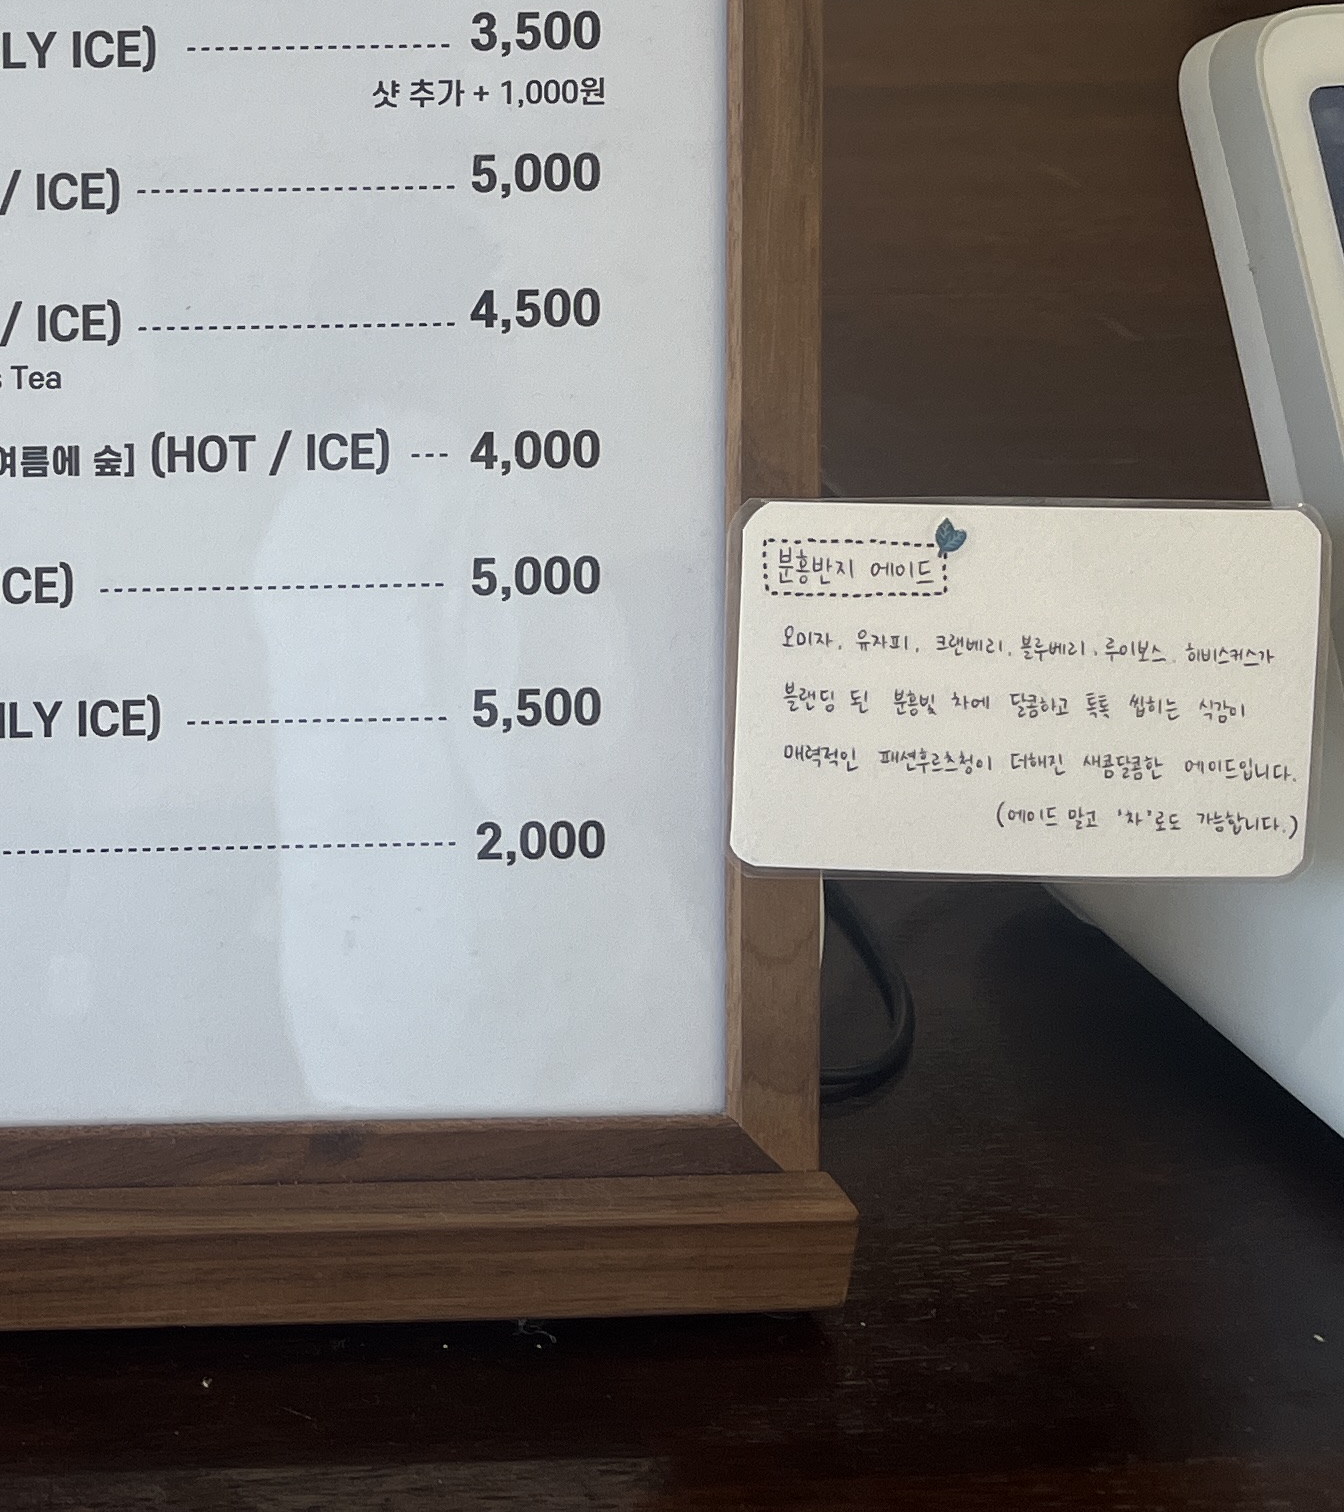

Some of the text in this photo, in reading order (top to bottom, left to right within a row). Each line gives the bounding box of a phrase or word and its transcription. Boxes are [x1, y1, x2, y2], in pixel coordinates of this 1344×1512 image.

[73, 25, 155, 72] ICE)
[471, 11, 600, 57] 3,500
[373, 80, 400, 108] 샷
[410, 79, 465, 107] 추가
[474, 86, 489, 101] +
[502, 78, 604, 108] 1,000원
[0, 301, 22, 347] /
[38, 299, 120, 346] ICE)
[470, 288, 600, 334] 4,500
[11, 366, 61, 389] Tea
[94, 444, 134, 477] 숲]
[152, 432, 256, 478] (HOT
[269, 430, 292, 476] /
[307, 428, 389, 475] ICE)
[470, 430, 600, 476] 4,000
[779, 547, 934, 584] 분홍반지 에이드
[784, 682, 1244, 723] 블랜딩 된 분홍빛 차에 달콤하고 톡톡 씹히는 식감이
